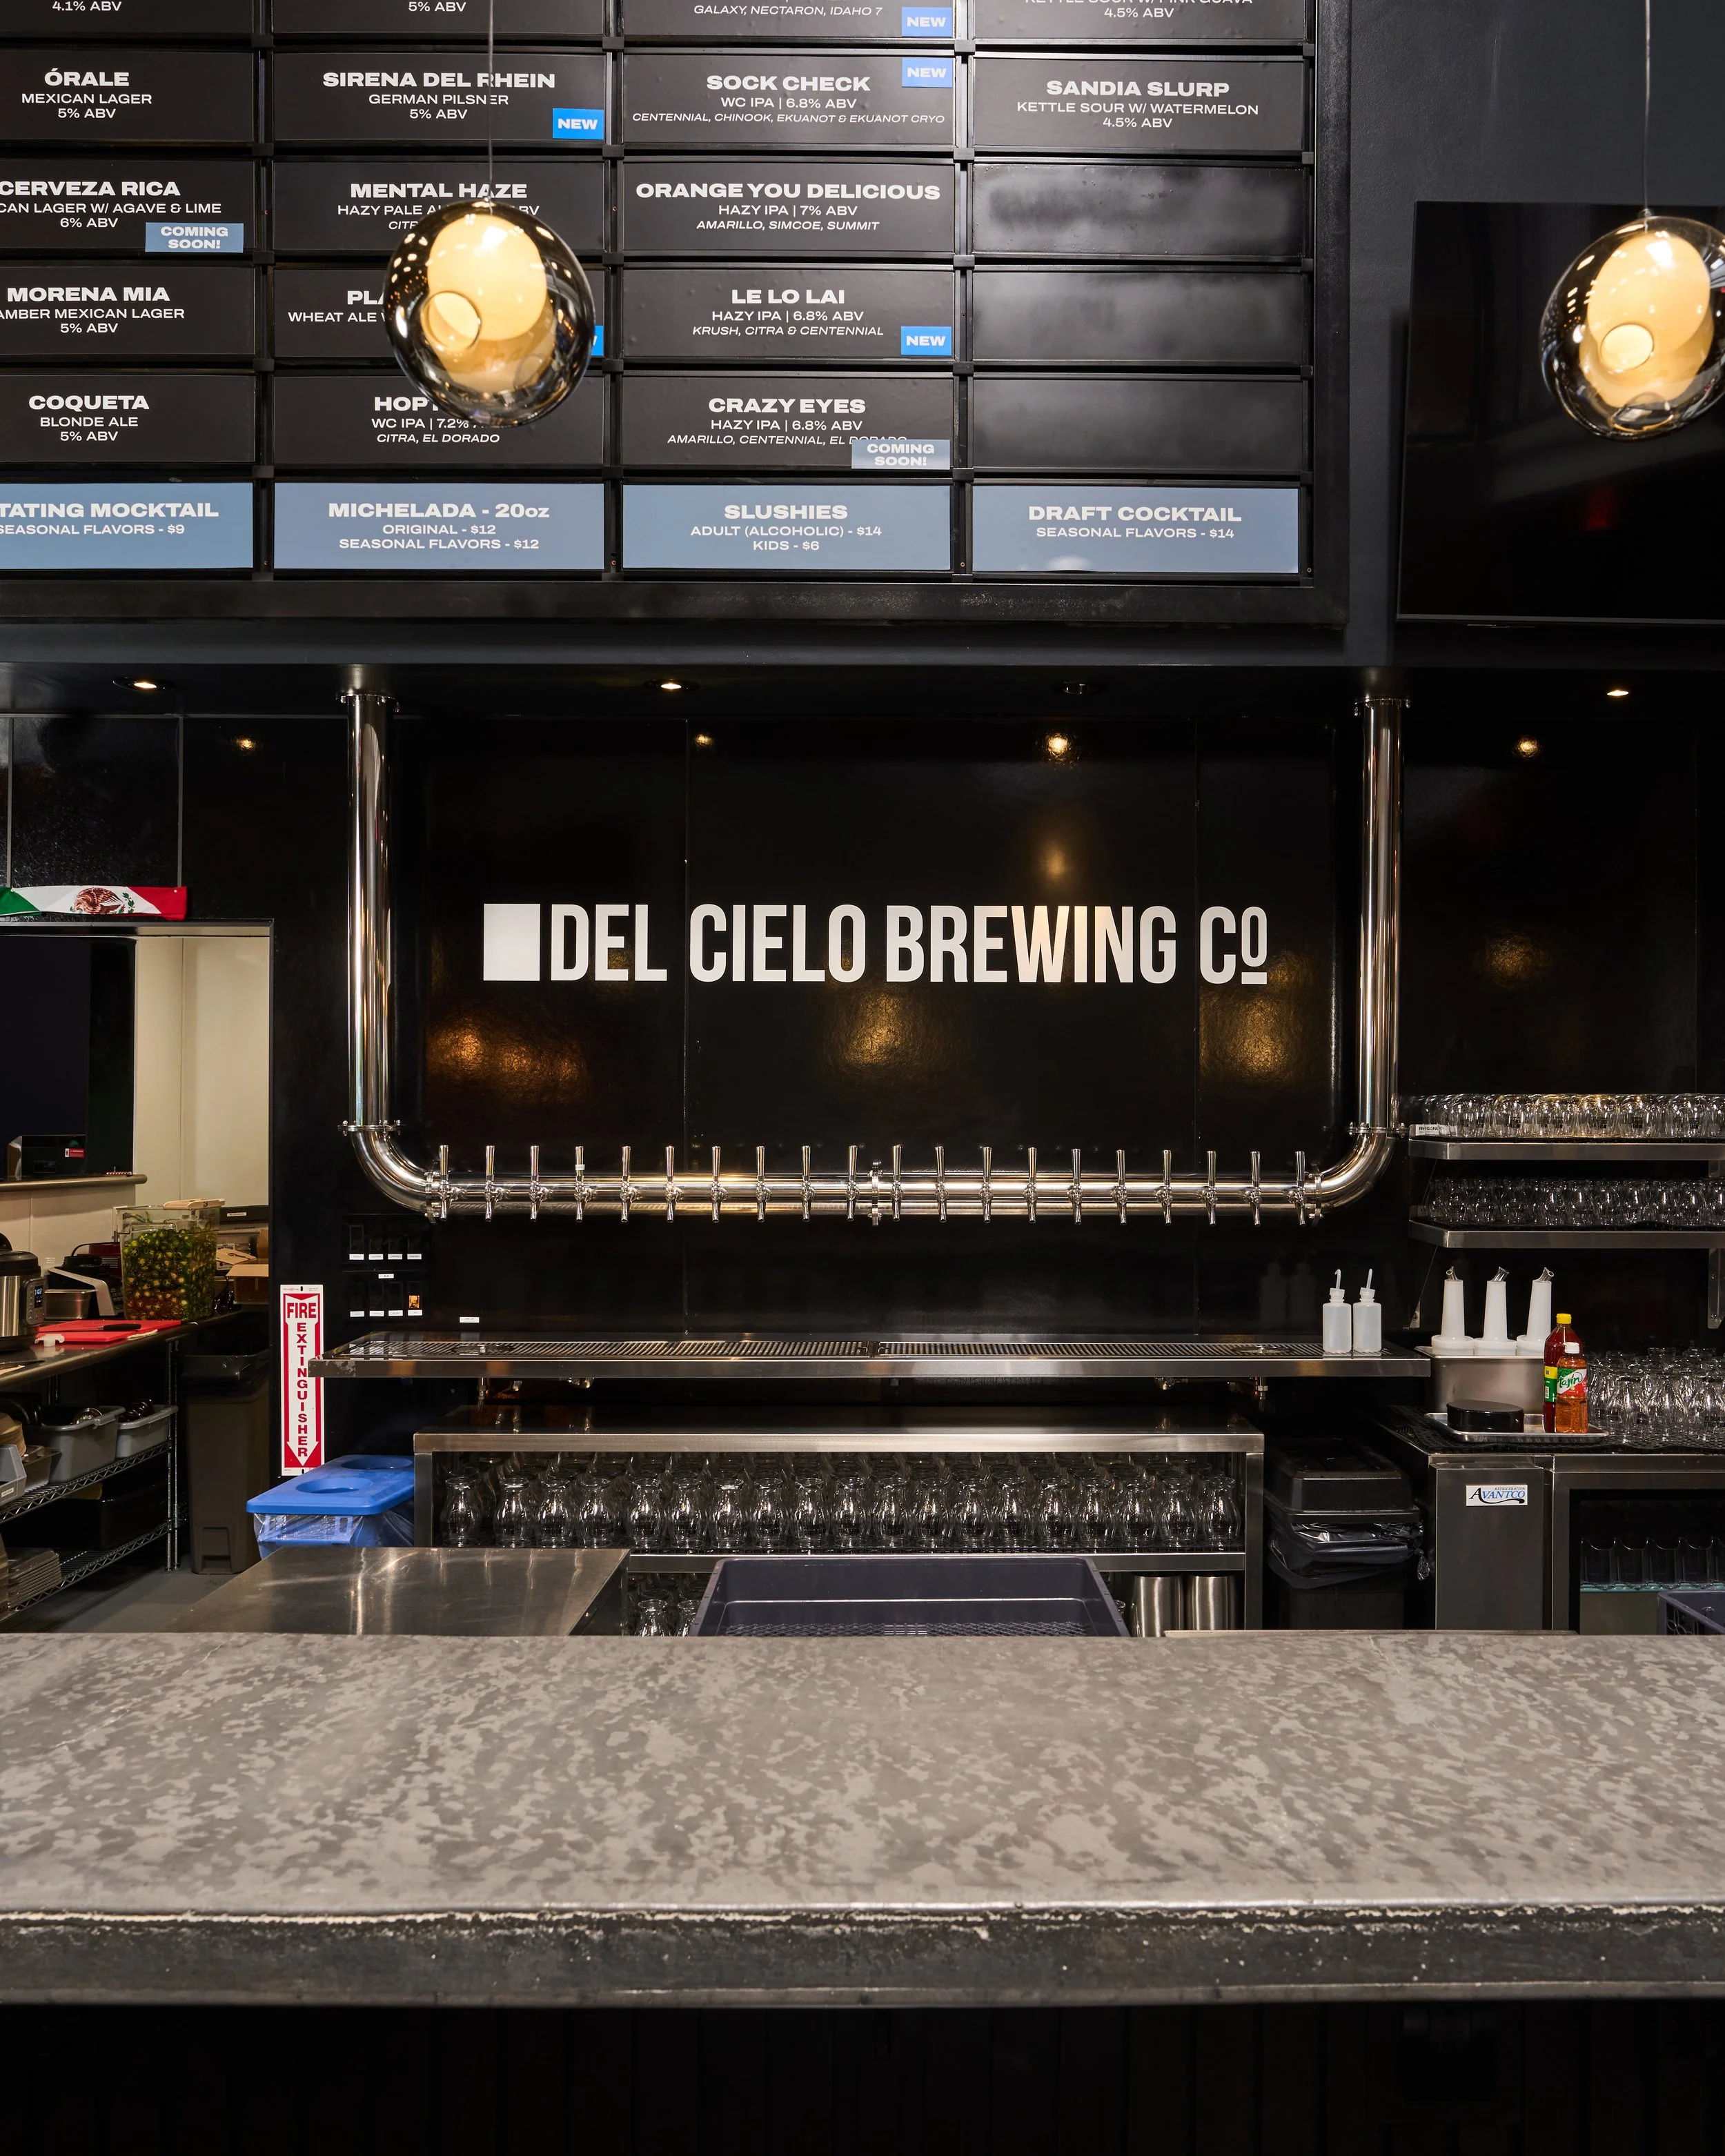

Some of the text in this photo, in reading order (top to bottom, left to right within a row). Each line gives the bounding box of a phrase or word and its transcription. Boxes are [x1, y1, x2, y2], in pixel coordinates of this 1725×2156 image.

[52, 1, 122, 12] 4.1% ABV
[408, 1, 466, 12] 5% ABV
[693, 5, 884, 17] GALAXY, NECTARON, IDAHO 7
[1103, 7, 1174, 18] 4.5% ABV
[907, 17, 947, 28] NEW
[44, 68, 130, 87] ÓRALE
[907, 67, 947, 78] NEW
[323, 72, 555, 88] SIRENA DEL RHEIN
[707, 75, 871, 92] SOCK CHECK
[1046, 80, 1230, 97] SANDIA SLURP
[21, 93, 152, 104] MEXICAN LAGER
[368, 94, 509, 105] GERMAN PILSNER
[720, 97, 857, 109] WC IPA 6.8% ABV
[57, 108, 117, 119] 5% ABV
[409, 108, 468, 119] 5% ABV
[1016, 101, 1259, 115] KETTLE SOUR W/ WATERMELON
[632, 112, 711, 123] CENTENNIAL,
[714, 113, 773, 123] CHINOOK,
[776, 114, 836, 123] EKUANOT
[849, 114, 909, 123] EKUANOT
[911, 115, 945, 123] CRYO
[1103, 117, 1173, 128] 4.5% ABV
[558, 118, 598, 130] NEW
[0, 181, 181, 197] CERVEZA RICA
[351, 183, 527, 199] MENTAL HAZE
[635, 183, 940, 200] ORANGE YOU DELICIOUS
[34, 203, 86, 213] LAGER
[90, 203, 109, 214] W/
[112, 203, 166, 214] AGAVE
[186, 203, 221, 213] LIME
[337, 205, 381, 215] HAZY
[384, 205, 423, 215] PALE
[718, 205, 858, 216] HAZY IPA 7% ABV
[60, 217, 119, 228] 6% ABV
[696, 220, 880, 232] AMARILLO, SIMCOE, SUMMIT
[160, 226, 228, 237] COMING
[168, 239, 221, 249] SOON!
[7, 286, 170, 302] MORENA MIA
[731, 289, 845, 304] LE LO LAI
[55, 308, 127, 319] MEXICAN
[132, 308, 185, 319] LAGER
[288, 312, 377, 322] WHEAT ALE
[712, 310, 865, 322] HAZY IPA 6.8% ABV
[60, 323, 119, 333] 5% ABV
[692, 326, 741, 337] KRUSH,
[745, 326, 784, 335] CITRA
[800, 326, 884, 336] CENTENNIAL
[906, 335, 946, 346] NEW
[28, 395, 150, 412] COQUETA
[709, 397, 866, 414] CRAZY EYES
[40, 417, 139, 427] BLONDE ALE
[371, 418, 397, 428] WC
[401, 418, 426, 428] IPA
[436, 418, 469, 428] 7.2%
[711, 419, 863, 431] HAZY IPA 6.8% ABV
[60, 431, 119, 442] 5% ABV
[377, 433, 500, 444] CITRA, EL DORADO
[667, 435, 736, 446] AMARILLO,
[740, 435, 826, 446] CENTENNIAL,
[829, 435, 846, 445] EL
[867, 443, 935, 454] COMING
[874, 456, 927, 468] SOON!
[90, 502, 219, 518] MOCKTAIL
[328, 503, 550, 518] MICHELADA 20oz
[724, 504, 848, 520] SLUSHIES
[1029, 506, 1242, 522] DRAFT COCKTAIL
[0, 524, 185, 535] SEASONAL FLAVORS $9
[382, 524, 496, 535] ORIGINAL $12
[690, 525, 883, 538] ADULT (ALCOHOLIC) $14
[1036, 527, 1234, 539] SEASONAL FLAVORS $14
[339, 538, 540, 550] SEASONAL FLAVORS $12
[753, 540, 820, 551] KIDS $6
[551, 904, 667, 982] DEL
[689, 903, 866, 983] CIELO
[886, 904, 1176, 984] BREWING
[286, 1302, 317, 1318] FIRE
[296, 1322, 308, 1457] EXTINGUISHER
